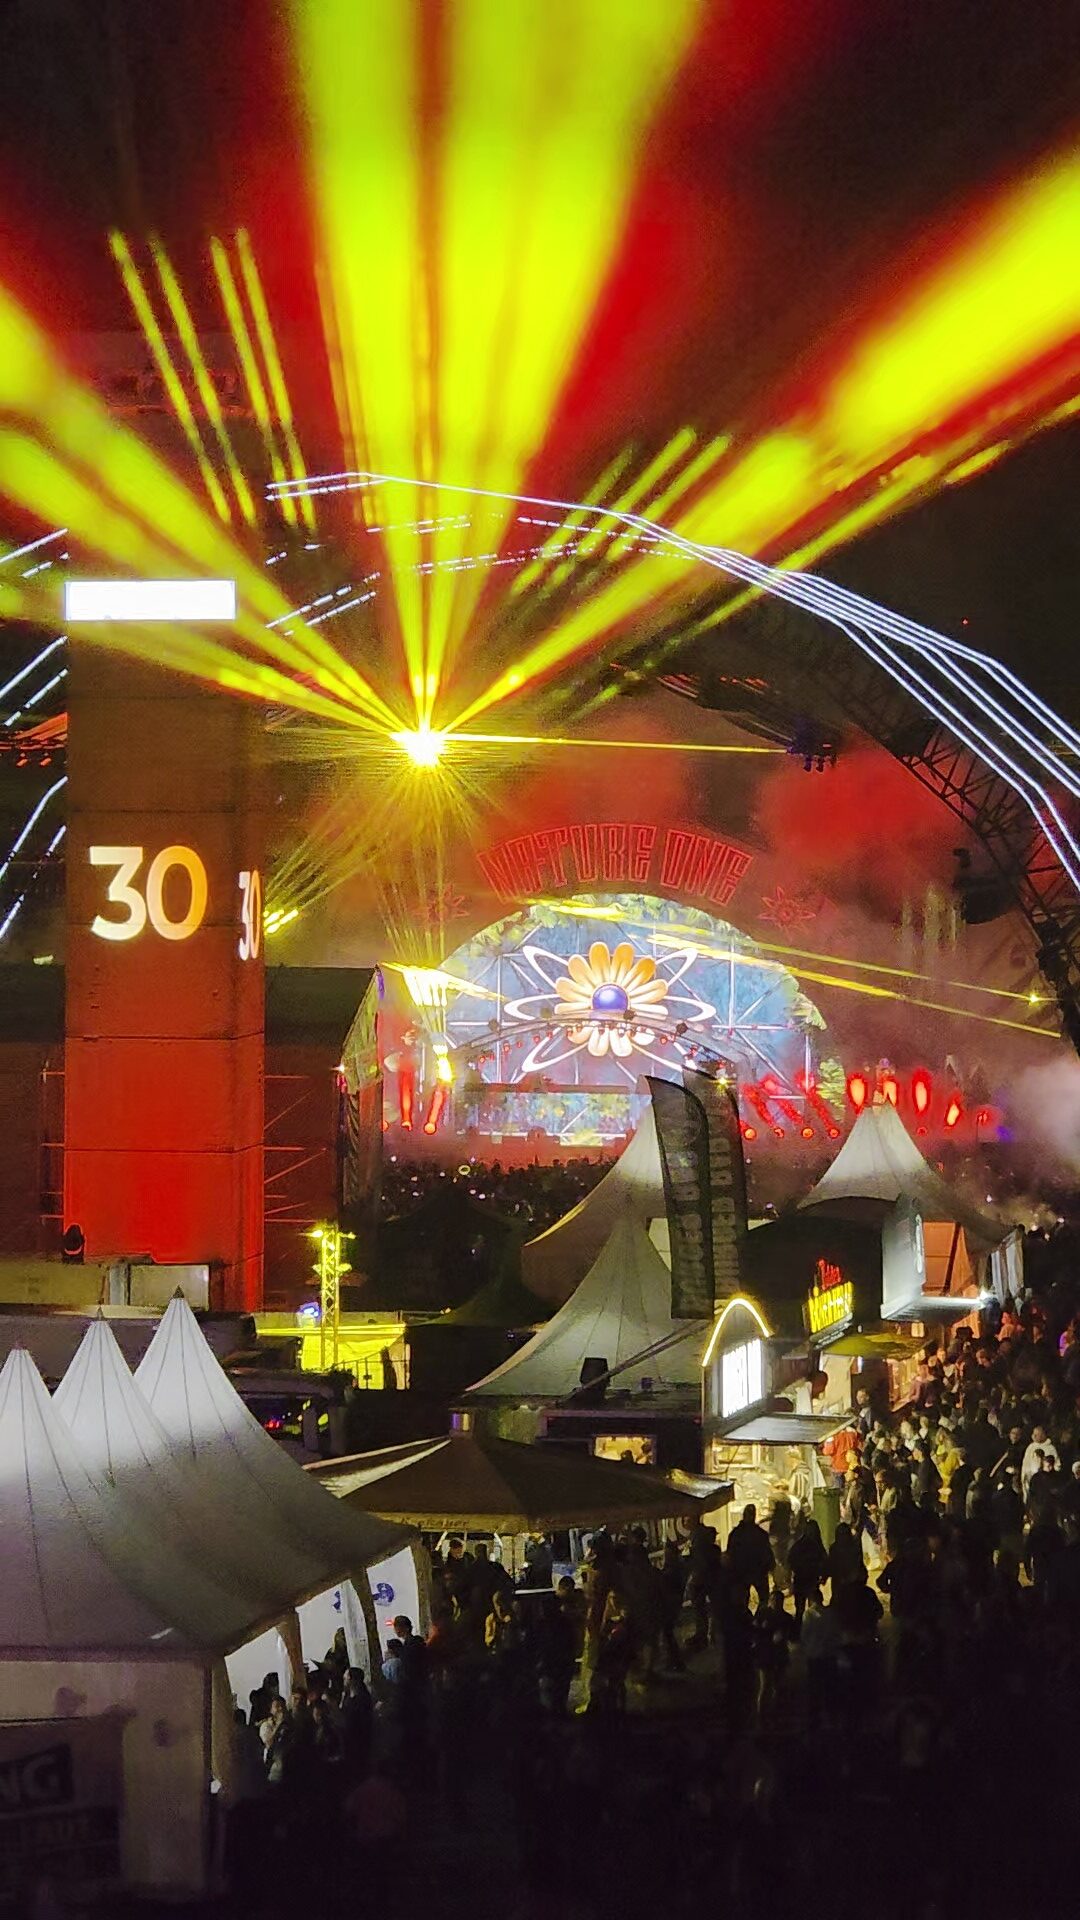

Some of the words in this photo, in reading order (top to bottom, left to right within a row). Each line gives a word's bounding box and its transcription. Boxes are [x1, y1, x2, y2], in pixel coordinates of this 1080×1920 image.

[89, 845, 208, 940] 30
[476, 823, 657, 904] NATURE
[660, 829, 753, 907] ONE
[238, 869, 262, 961] 30
